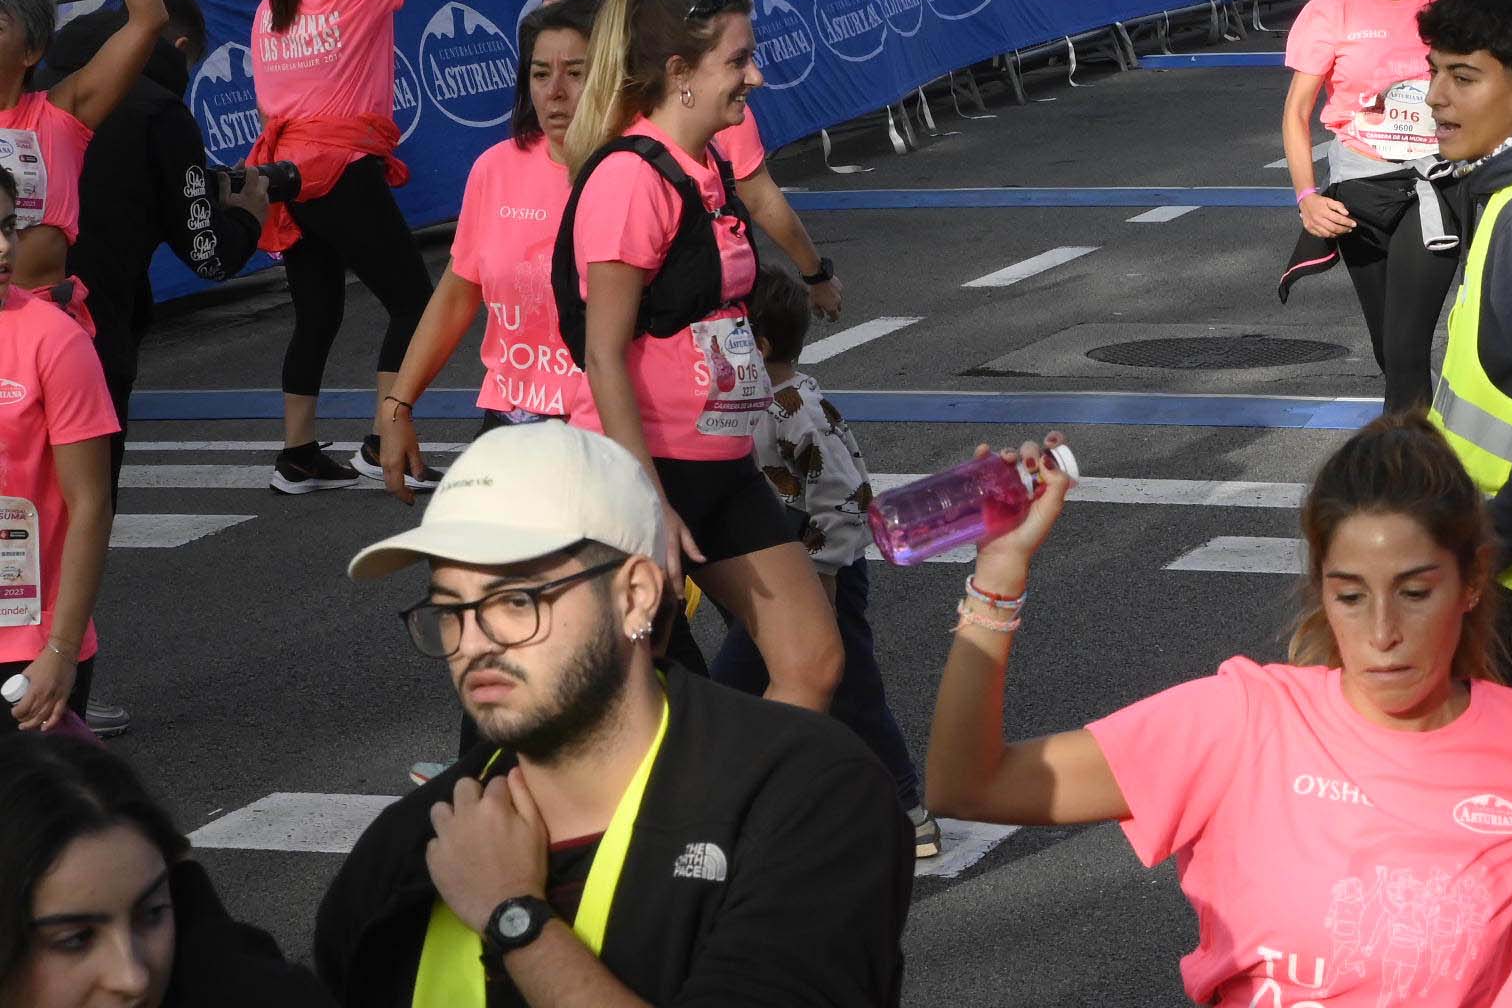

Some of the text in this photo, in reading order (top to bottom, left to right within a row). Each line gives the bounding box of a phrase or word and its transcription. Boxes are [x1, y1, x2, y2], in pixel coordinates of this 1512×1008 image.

[259, 36, 279, 63] LAS
[429, 53, 518, 102] ASTURIANA
[1389, 107, 1421, 123] 016
[499, 205, 548, 222] OYSHO
[490, 301, 521, 332] TU
[737, 364, 758, 382] 016
[495, 373, 565, 417] SUMA
[705, 417, 739, 428] OYSHO
[1257, 945, 1325, 990] TU
